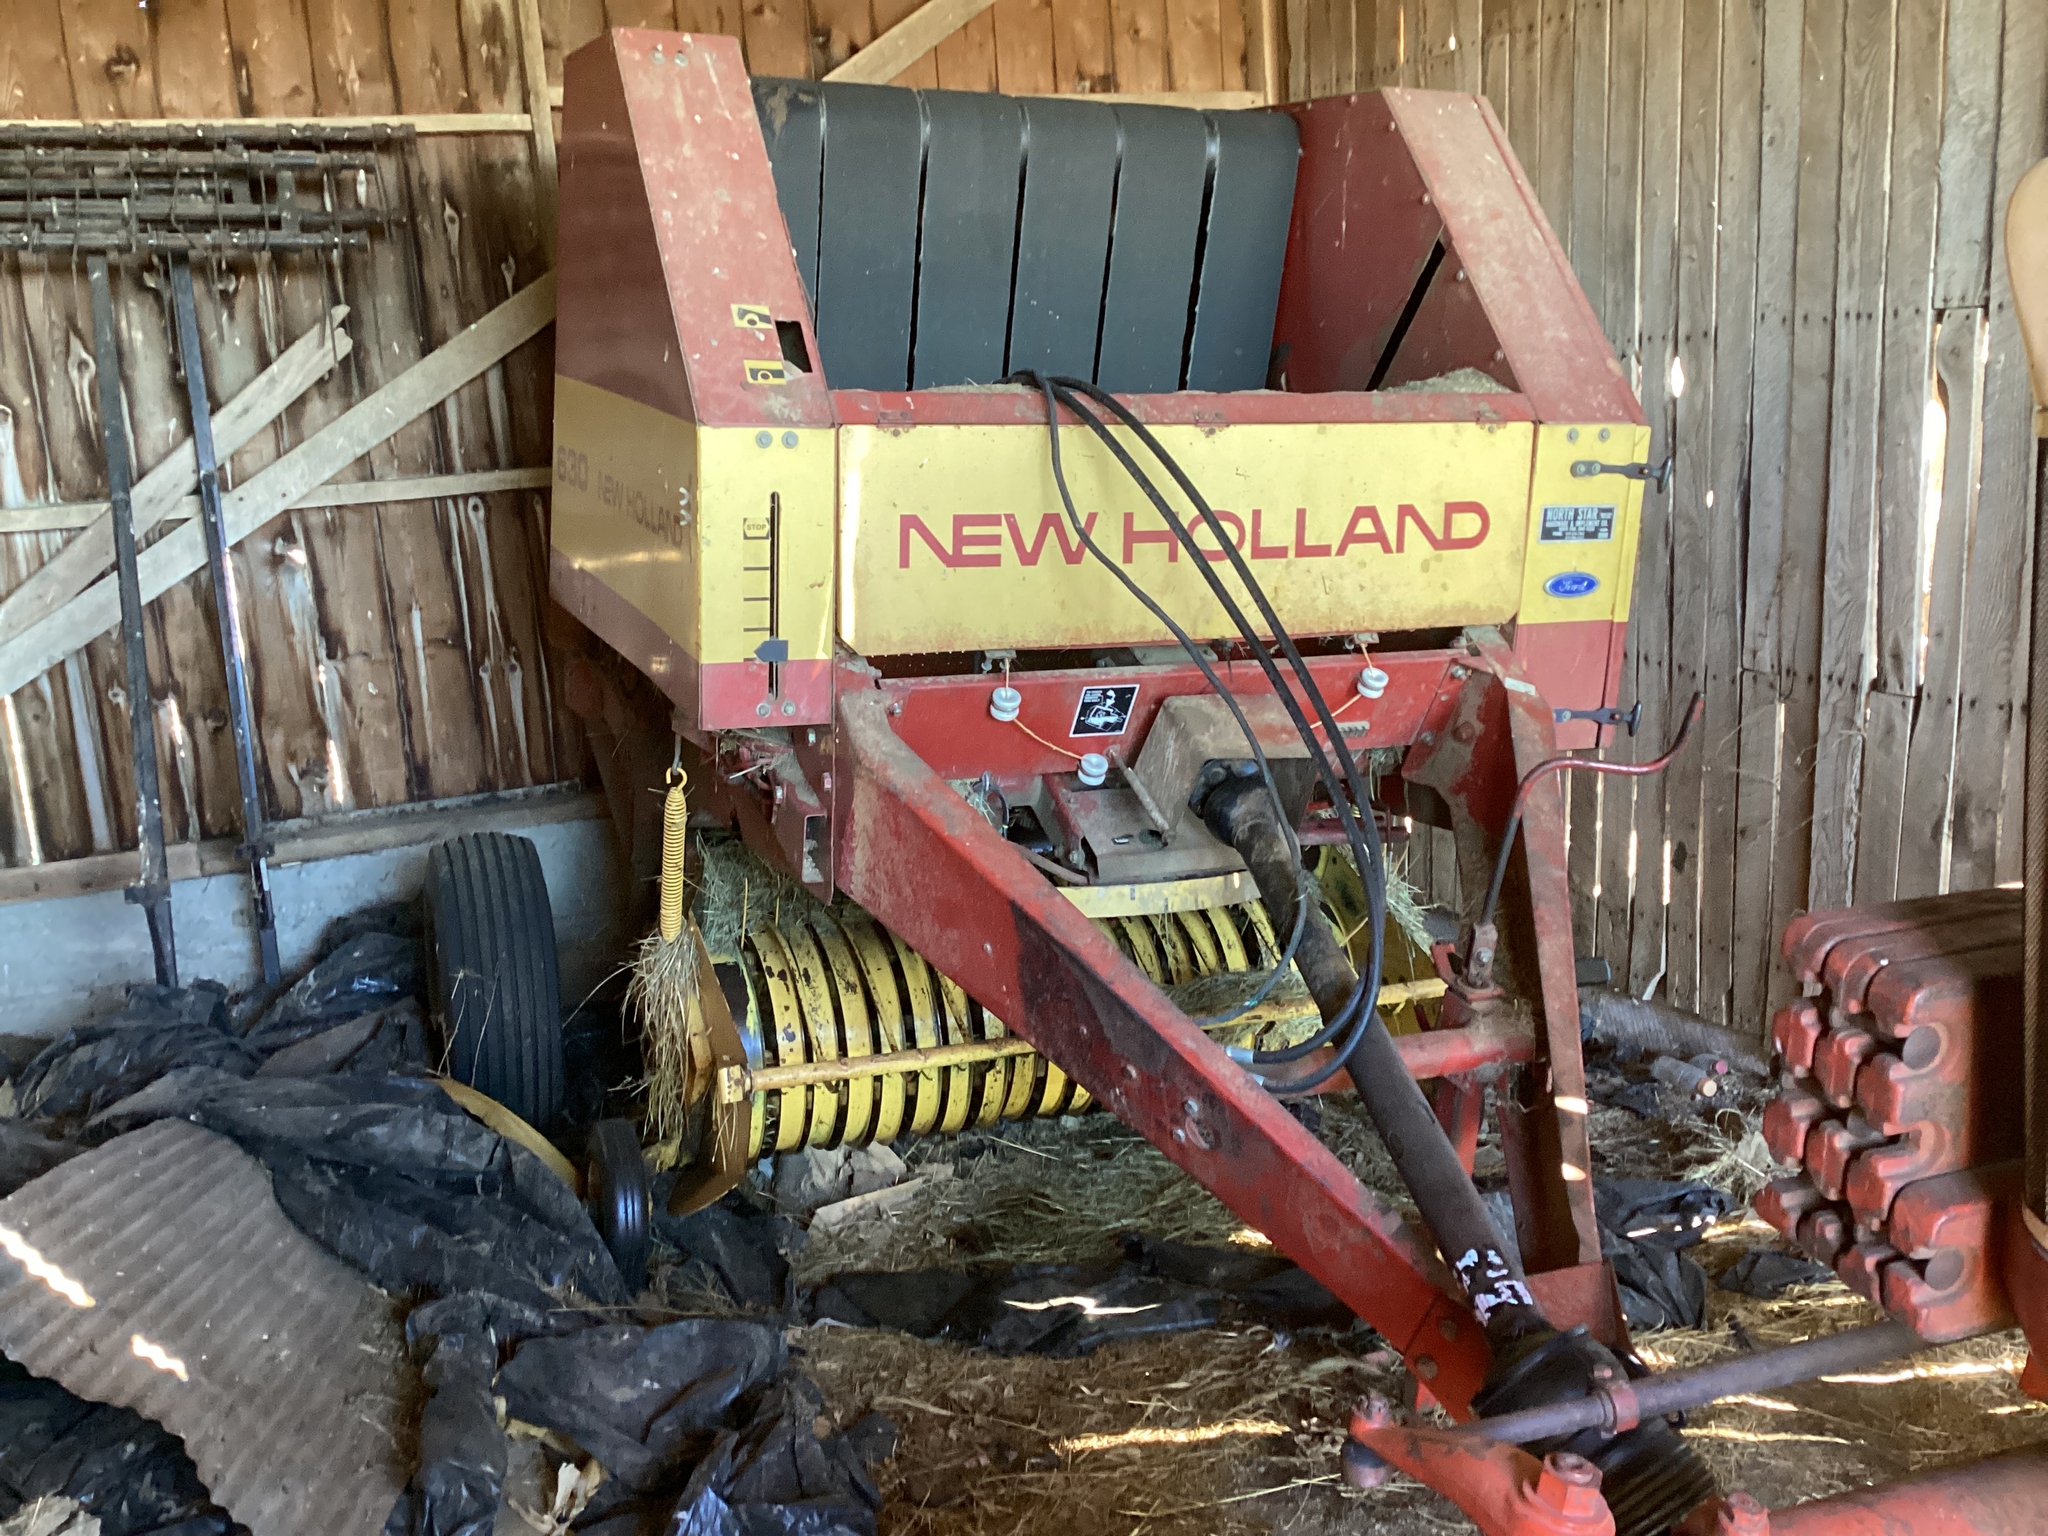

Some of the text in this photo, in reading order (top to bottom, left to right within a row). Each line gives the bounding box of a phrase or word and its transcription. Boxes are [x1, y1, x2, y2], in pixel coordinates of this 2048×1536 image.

[626, 485, 683, 548] HOLLAND
[1546, 507, 1575, 521] NORTH
[1577, 507, 1599, 520] STAR
[746, 523, 767, 531] STOP
[899, 501, 1491, 569] NEW HOLLAND
[1558, 579, 1588, 592] Ford
